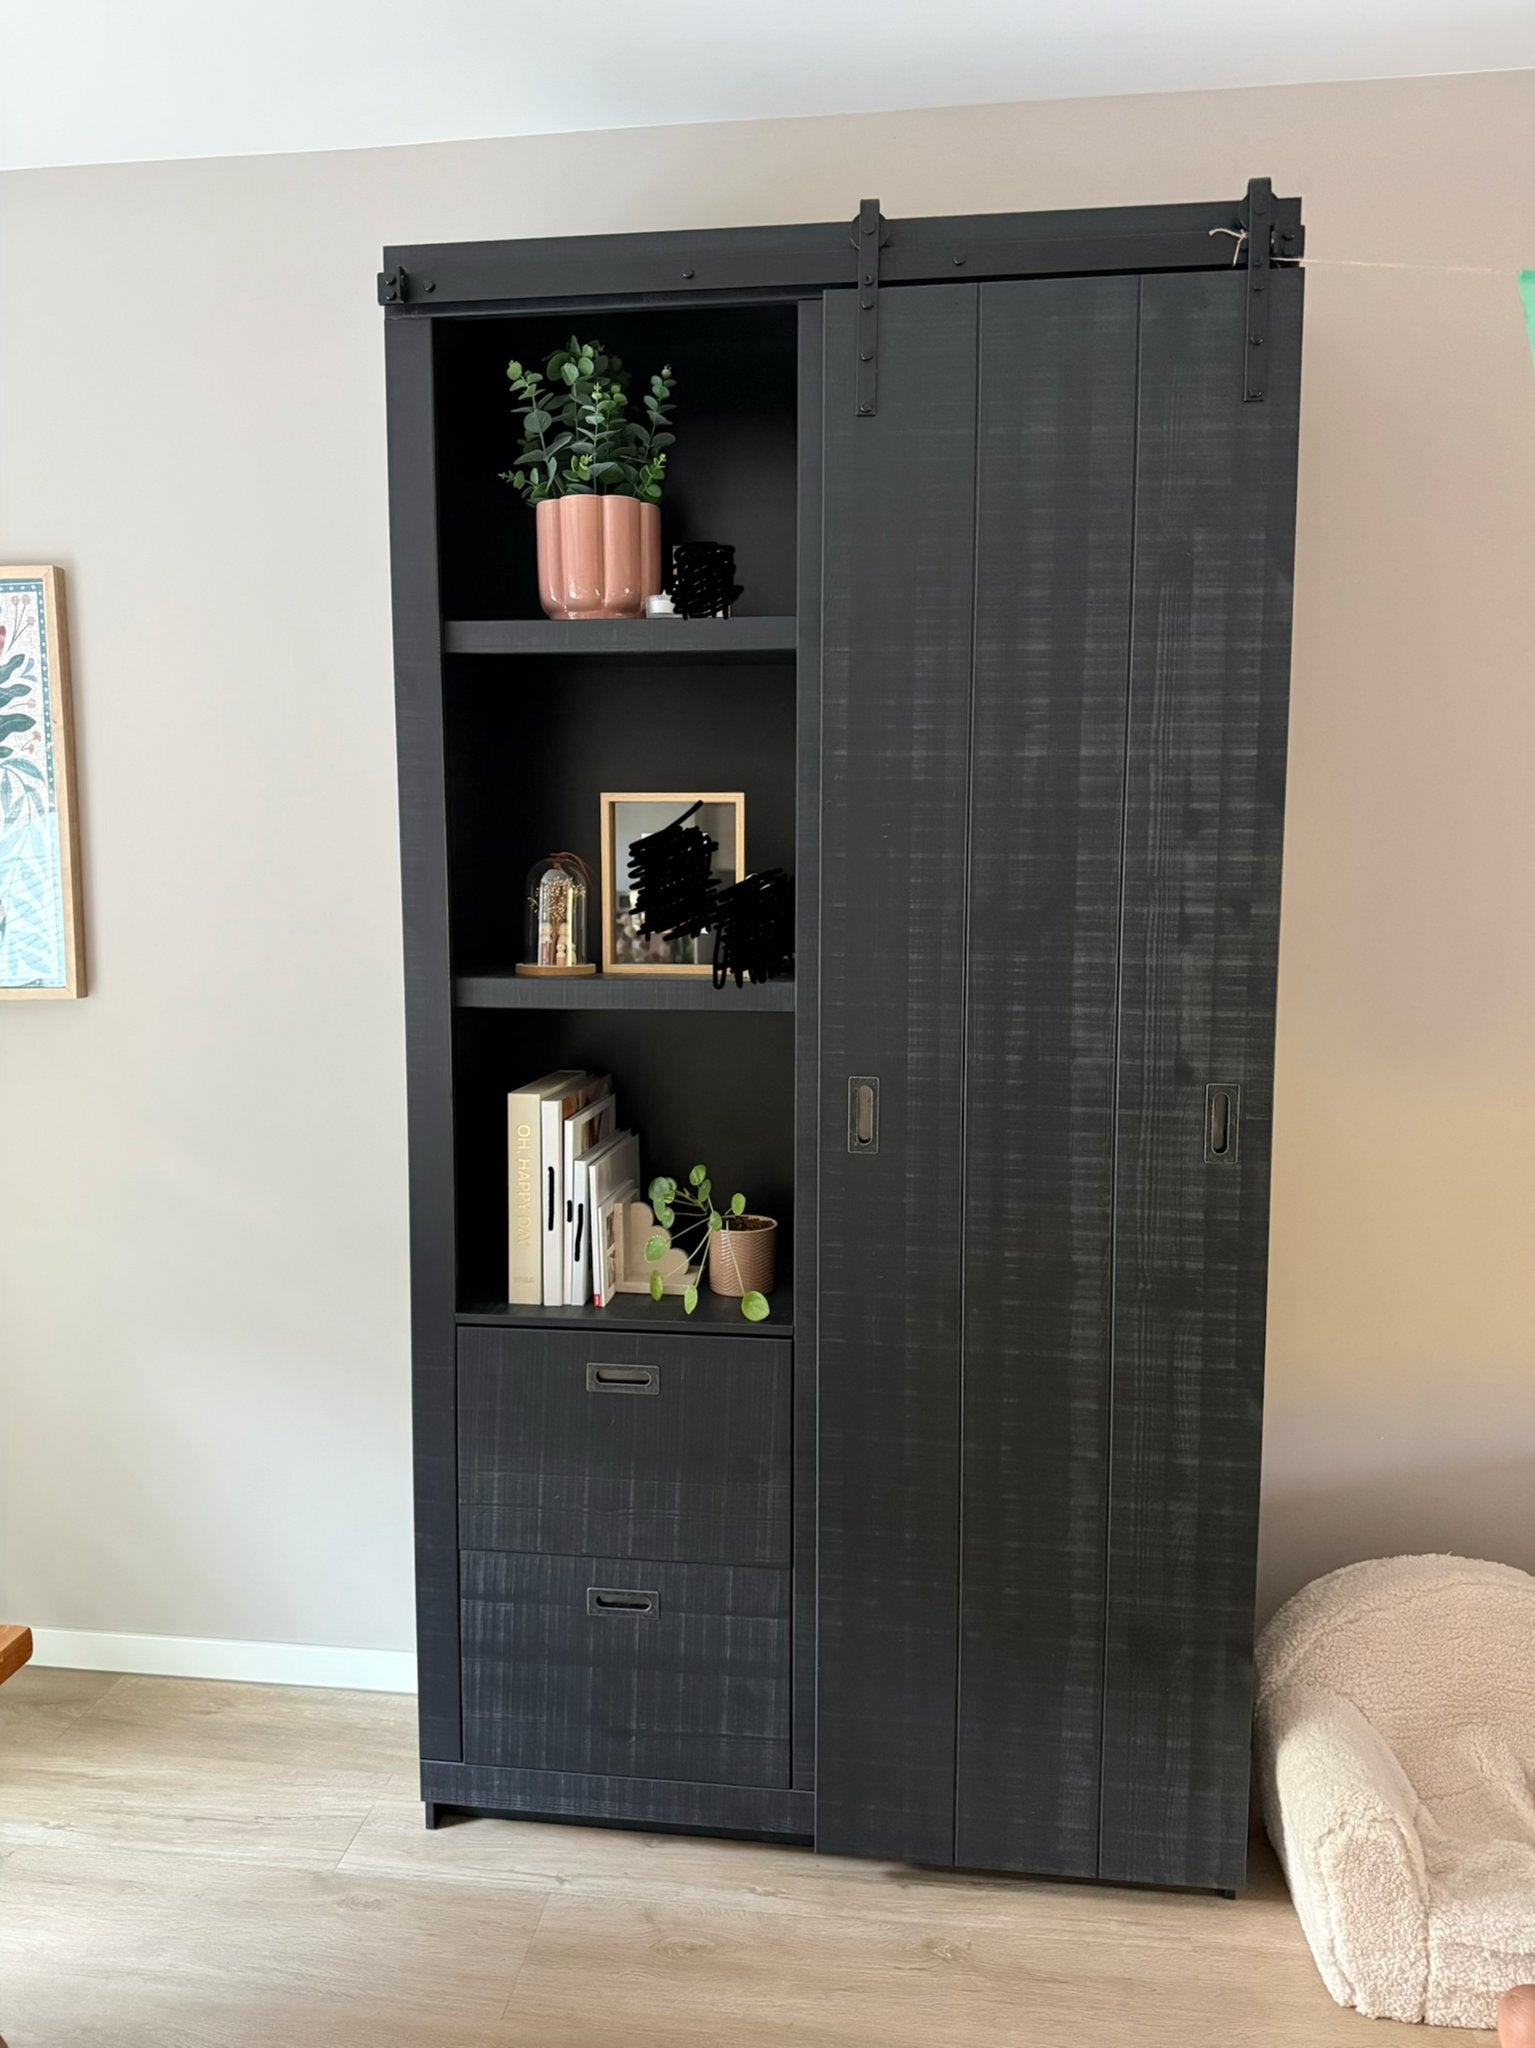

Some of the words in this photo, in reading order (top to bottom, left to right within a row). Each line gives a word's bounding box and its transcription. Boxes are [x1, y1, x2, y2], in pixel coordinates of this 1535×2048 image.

[516, 1124, 532, 1153] OH,
[517, 1158, 532, 1210] HAPPY
[517, 1215, 532, 1246] DAY
